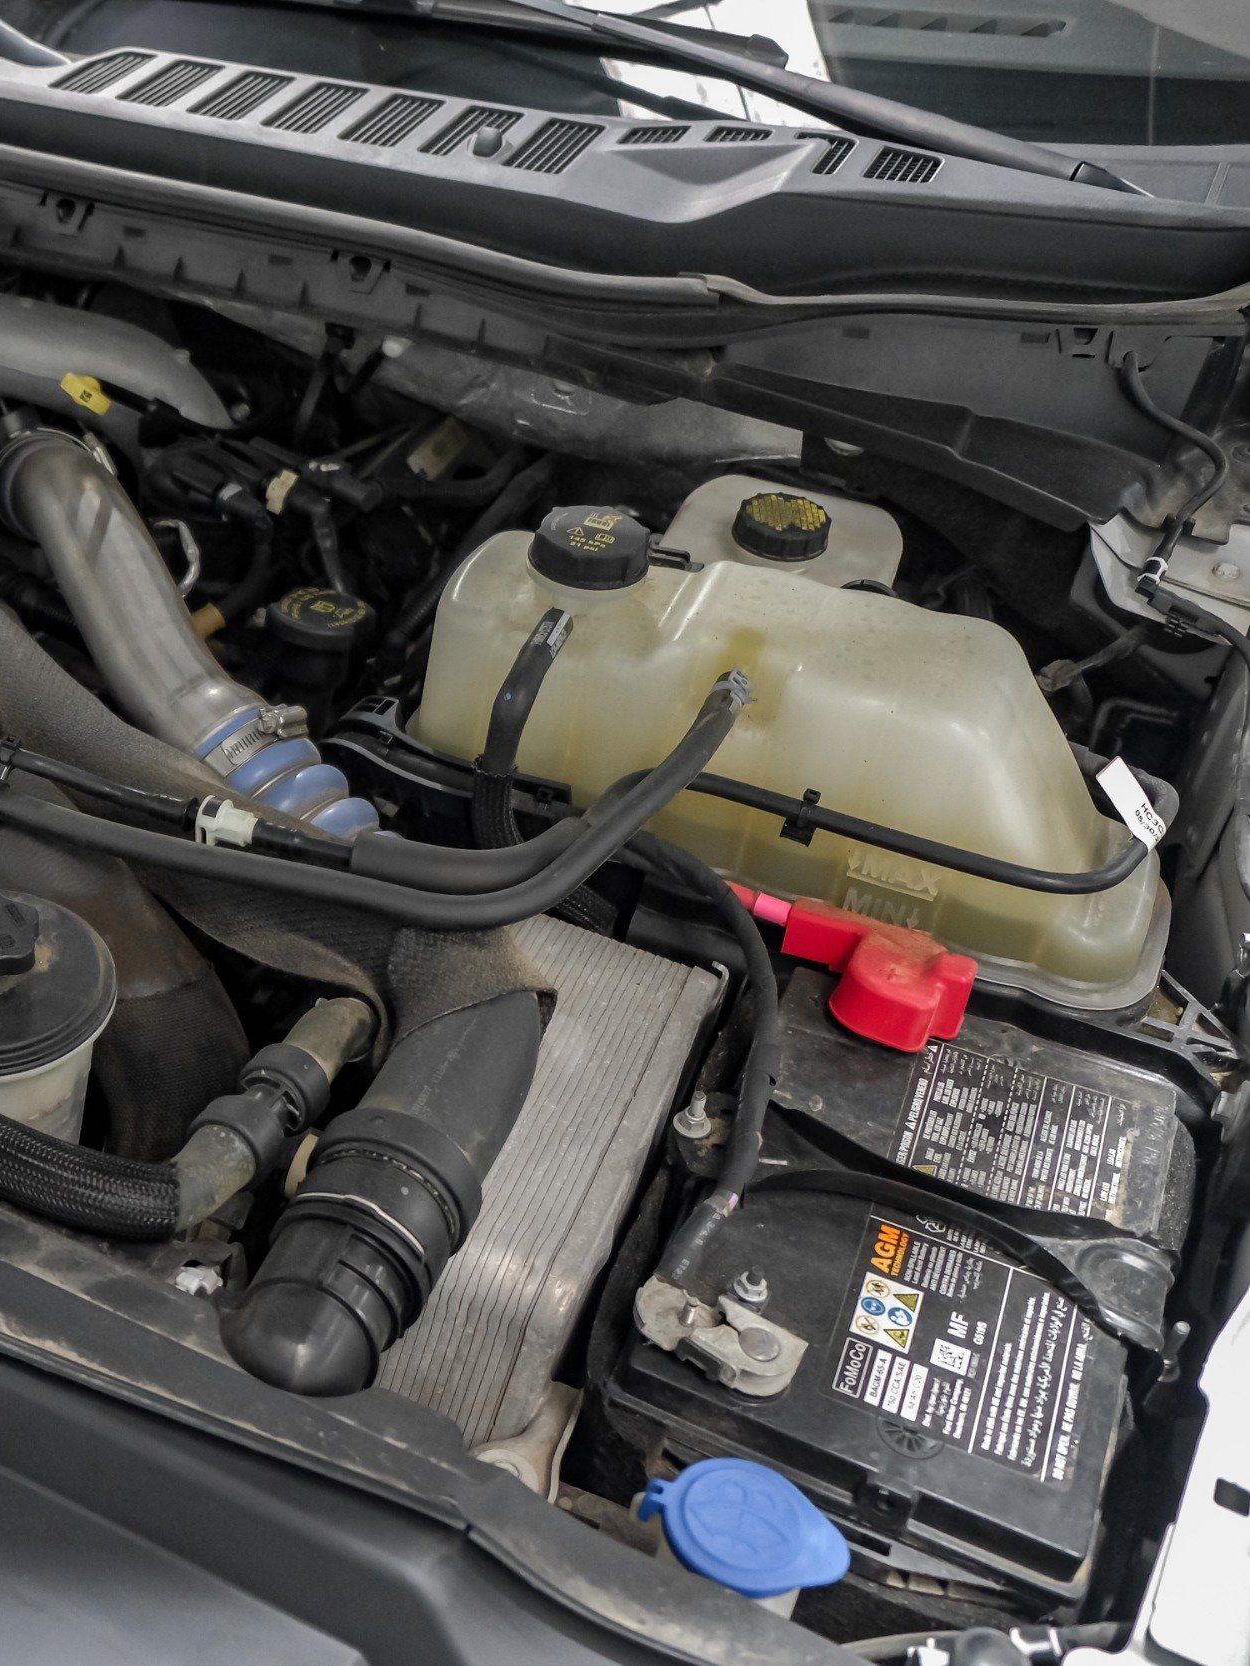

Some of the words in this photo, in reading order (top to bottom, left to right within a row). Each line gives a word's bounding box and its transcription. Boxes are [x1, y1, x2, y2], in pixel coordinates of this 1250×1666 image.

[861, 852, 942, 897] MAX
[842, 887, 907, 925] MIN
[868, 1223, 901, 1274] AGM
[890, 1231, 910, 1277] TECHNOLOGY
[946, 1310, 970, 1339] MF
[838, 1340, 866, 1394] FoMoCo
